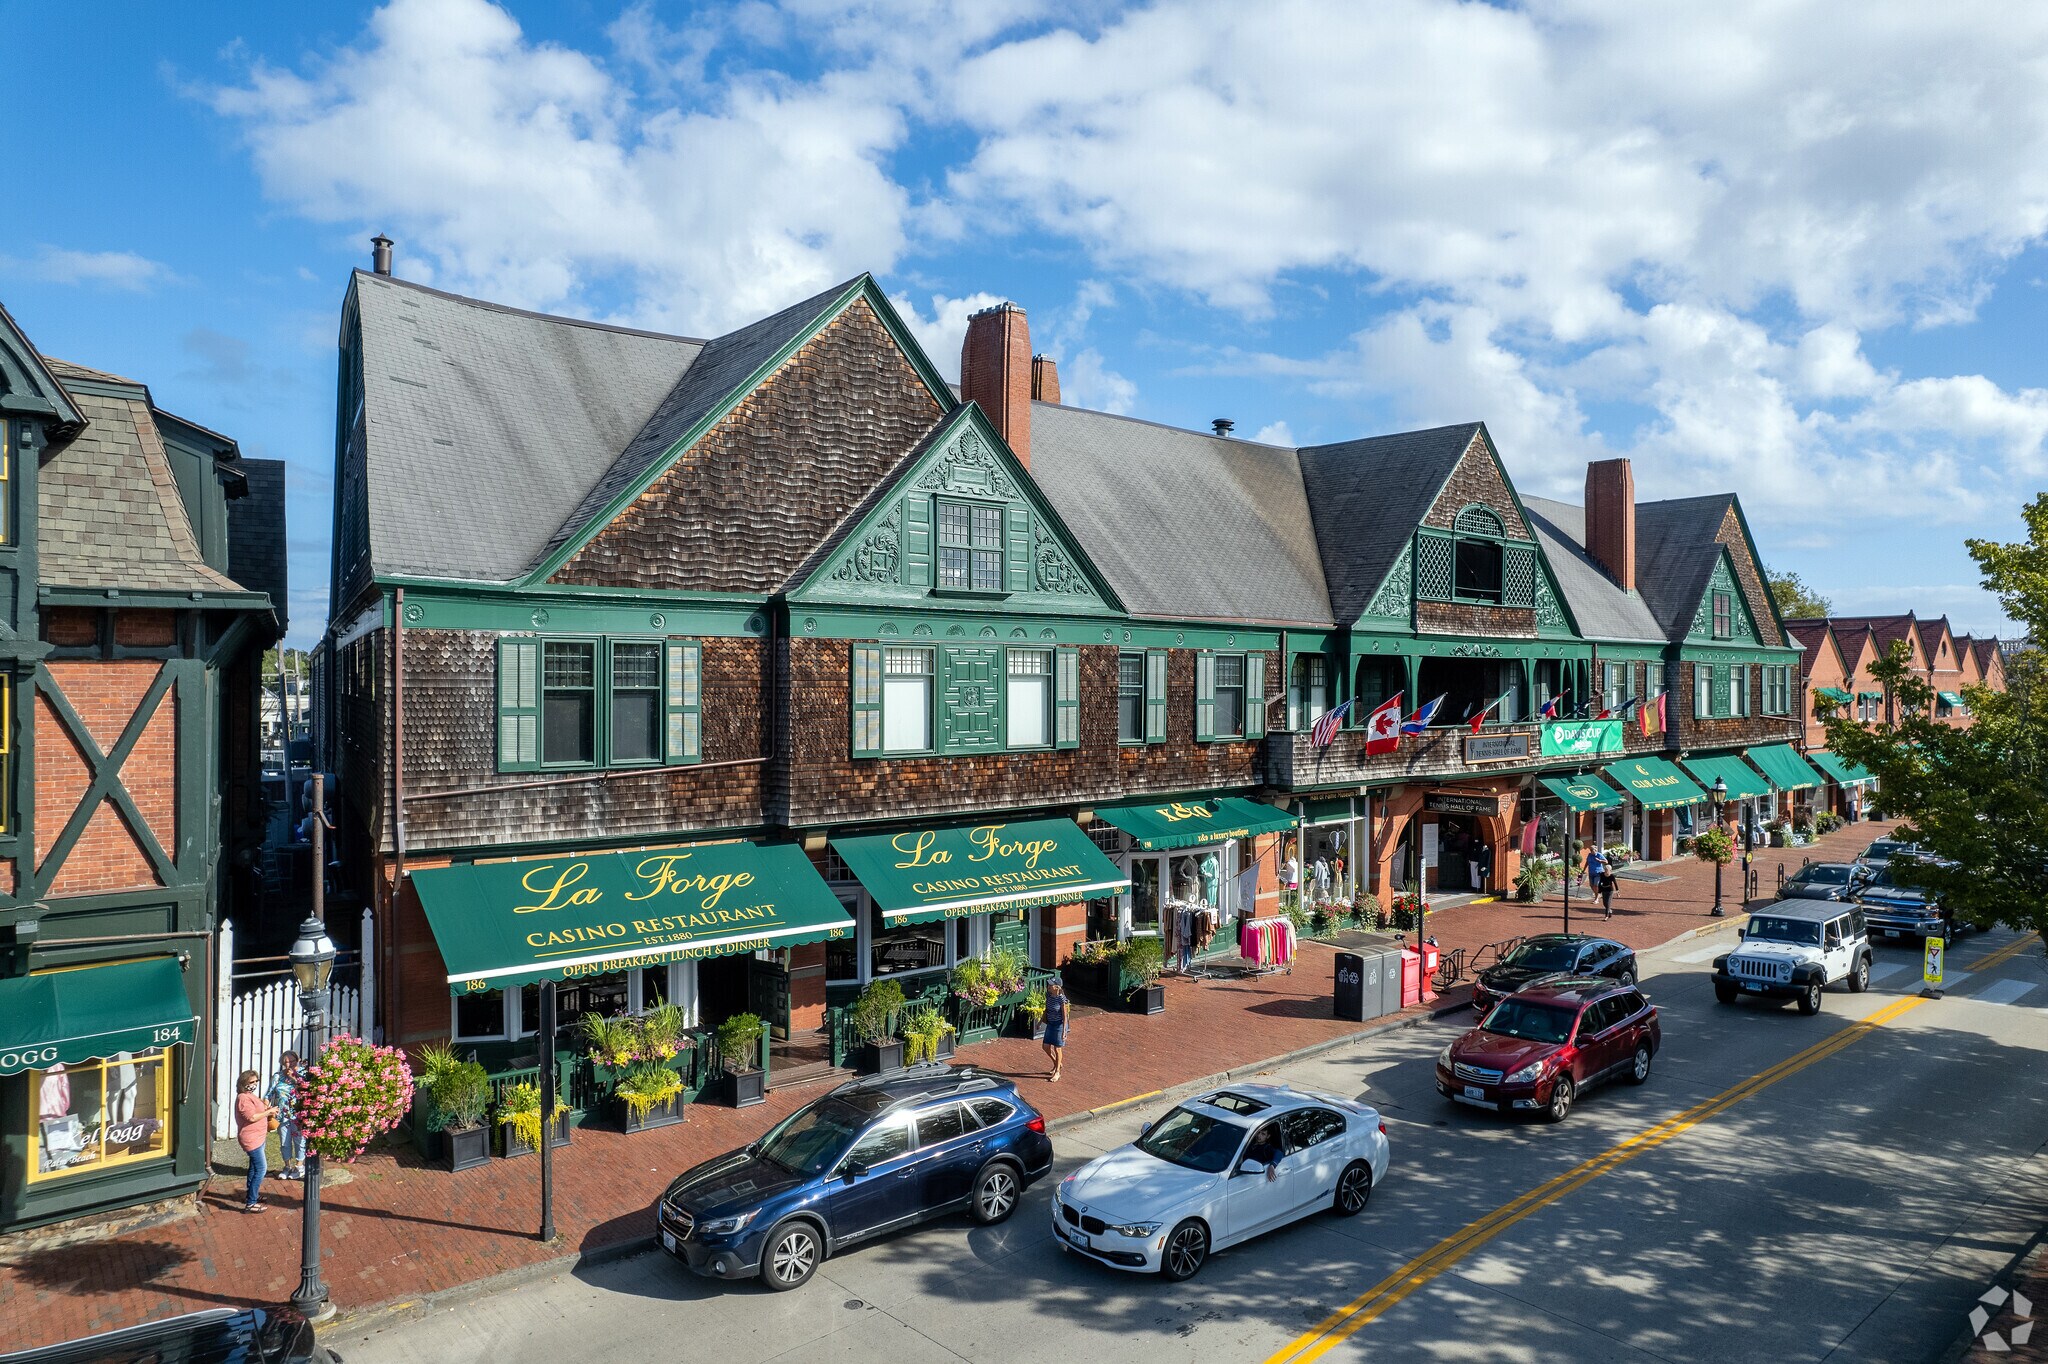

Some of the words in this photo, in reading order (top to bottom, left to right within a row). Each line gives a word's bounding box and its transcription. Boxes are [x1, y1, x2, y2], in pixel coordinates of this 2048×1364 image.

[1564, 729, 1586, 740] DAVIS
[1587, 728, 1602, 739] CUP
[1631, 779, 1653, 788] CLUB
[1651, 775, 1679, 786] CALAIS
[1438, 796, 1482, 805] INTERNATIONAL
[1475, 805, 1492, 813] FAME
[891, 830, 953, 870] La
[967, 824, 1058, 870] Forge
[513, 863, 604, 914] La
[624, 853, 755, 910] Forge
[912, 878, 980, 895] CASINO
[981, 865, 1084, 887] RESTAURANT
[993, 884, 1028, 895] EST.1880
[944, 906, 969, 918] OPEN
[970, 899, 1014, 915] BREAKFAST
[1015, 895, 1044, 909] LUNCH
[1045, 895, 1052, 905] &
[1053, 890, 1084, 903] DINNER
[526, 922, 627, 948] CASINO
[631, 904, 778, 935] RESTAURANT
[893, 914, 908, 924] 186
[641, 931, 693, 946] EST.1880
[828, 927, 844, 938] 186
[562, 963, 598, 978] OPEN
[602, 951, 668, 972] BREAKFAST
[669, 944, 713, 962] LUNCH
[715, 942, 724, 955] &
[726, 937, 772, 953] DINNER
[464, 978, 487, 991] 186
[152, 1026, 181, 1043] 184
[0, 1047, 58, 1068] OGG
[69, 1150, 97, 1165] Beach
